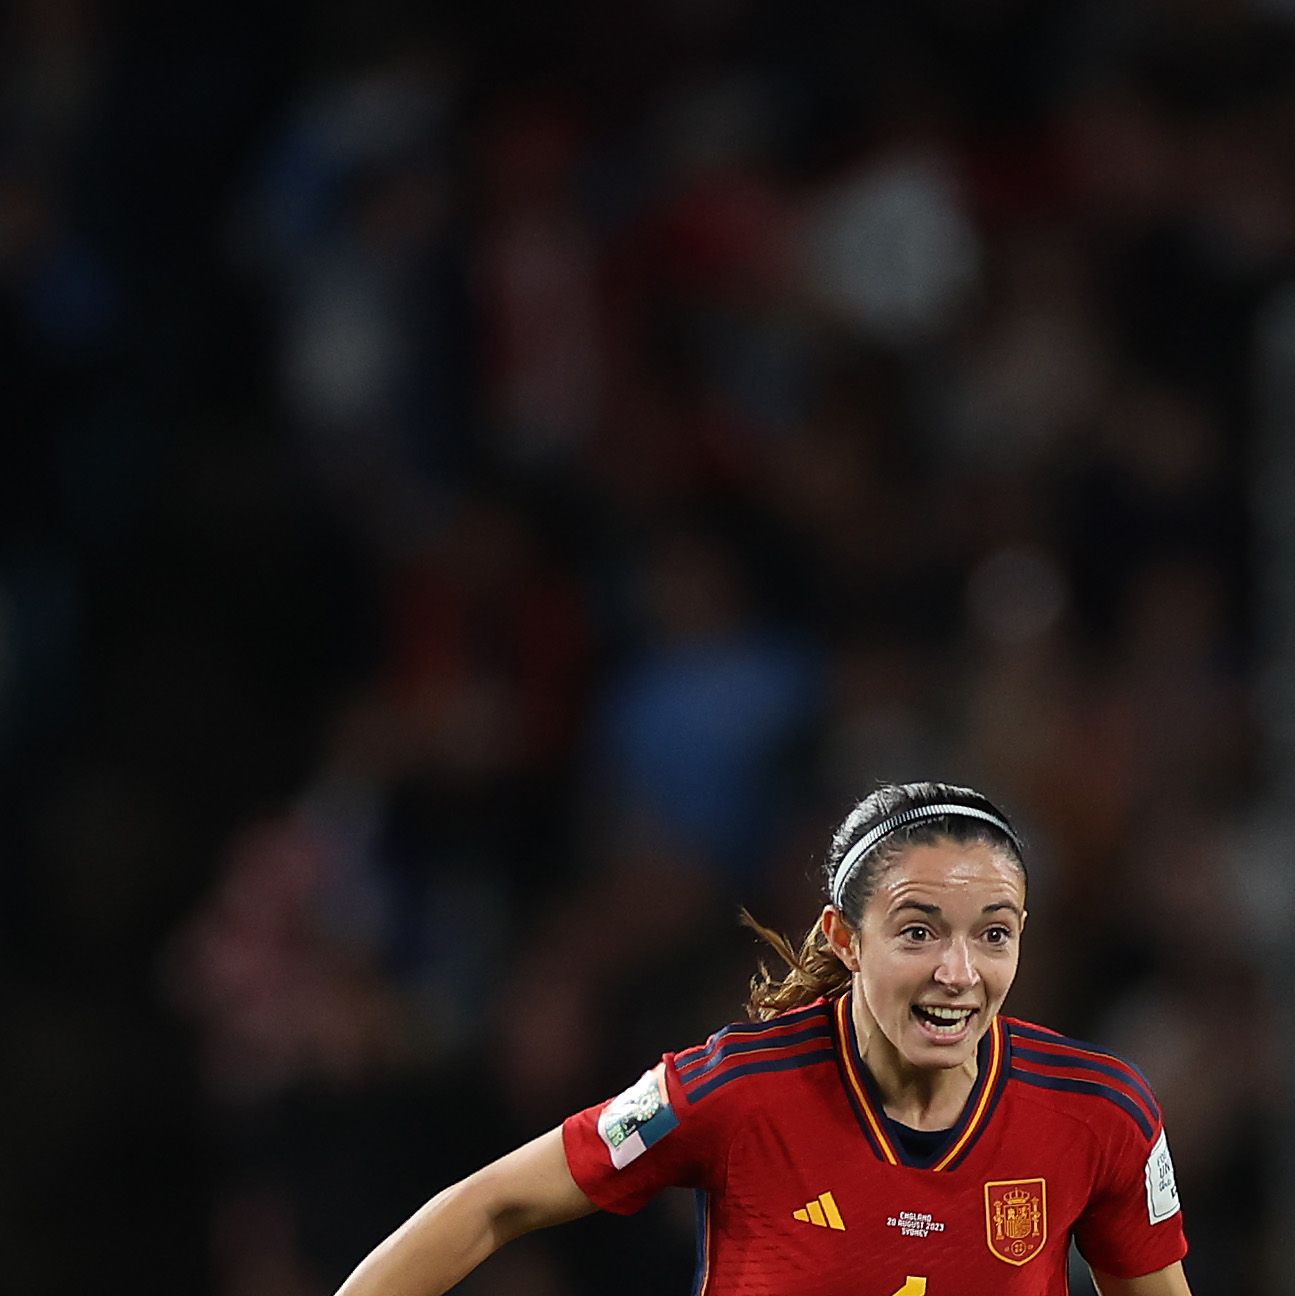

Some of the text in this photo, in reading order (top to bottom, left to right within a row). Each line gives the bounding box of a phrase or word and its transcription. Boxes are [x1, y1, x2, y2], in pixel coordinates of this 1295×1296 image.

[900, 1212, 932, 1222] ENGLAND
[887, 1217, 944, 1231] 20 AUGUST 2023
[902, 1228, 928, 1237] SYDNEY
